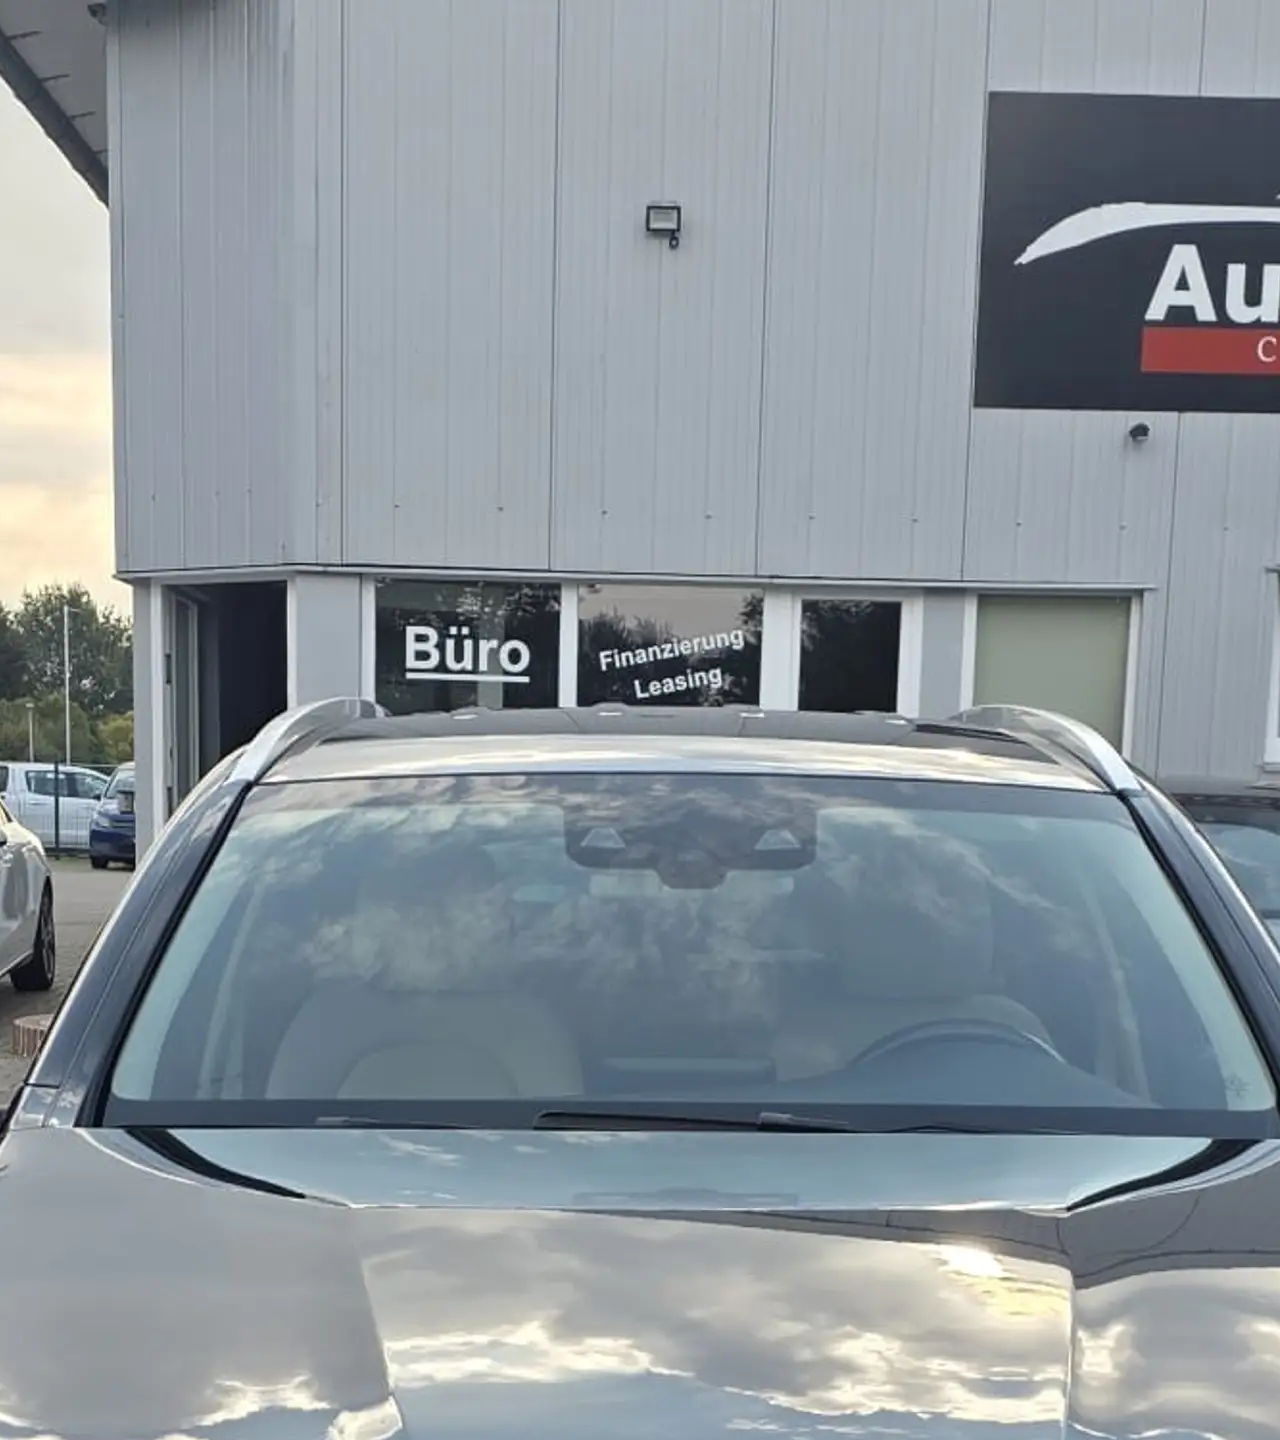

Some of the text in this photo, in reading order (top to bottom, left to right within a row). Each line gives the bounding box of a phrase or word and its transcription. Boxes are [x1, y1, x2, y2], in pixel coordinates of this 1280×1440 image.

[404, 625, 531, 674] Büro
[599, 627, 745, 671] Finanzierung
[634, 666, 724, 699] Leasing
